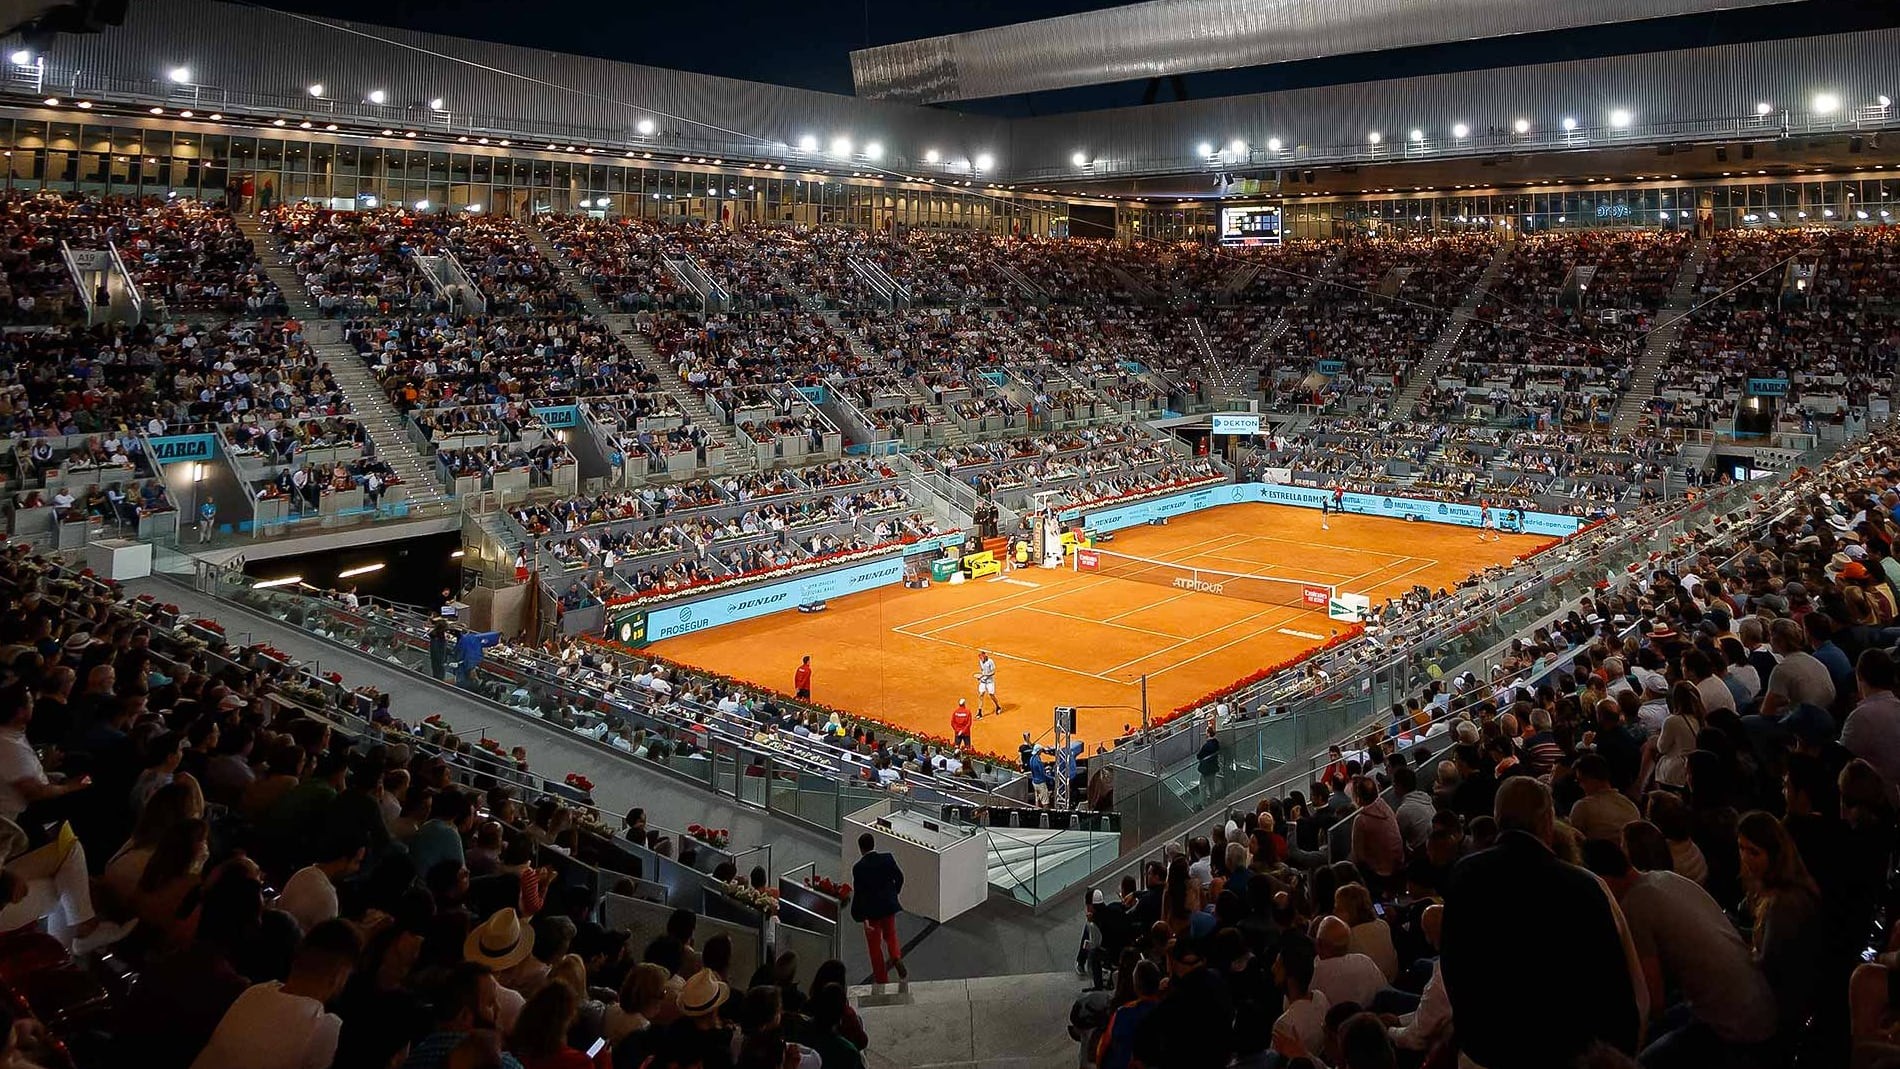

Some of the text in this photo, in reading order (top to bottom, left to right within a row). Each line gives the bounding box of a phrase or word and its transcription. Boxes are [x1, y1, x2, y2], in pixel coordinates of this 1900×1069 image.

[541, 410, 572, 425] ARCA
[1269, 490, 1301, 502] ESTRELLA
[1161, 500, 1187, 512] DUNLOP
[857, 566, 900, 583] DUNLOP
[737, 593, 788, 611] DUNLOP
[660, 618, 710, 638] PROSEGUR
